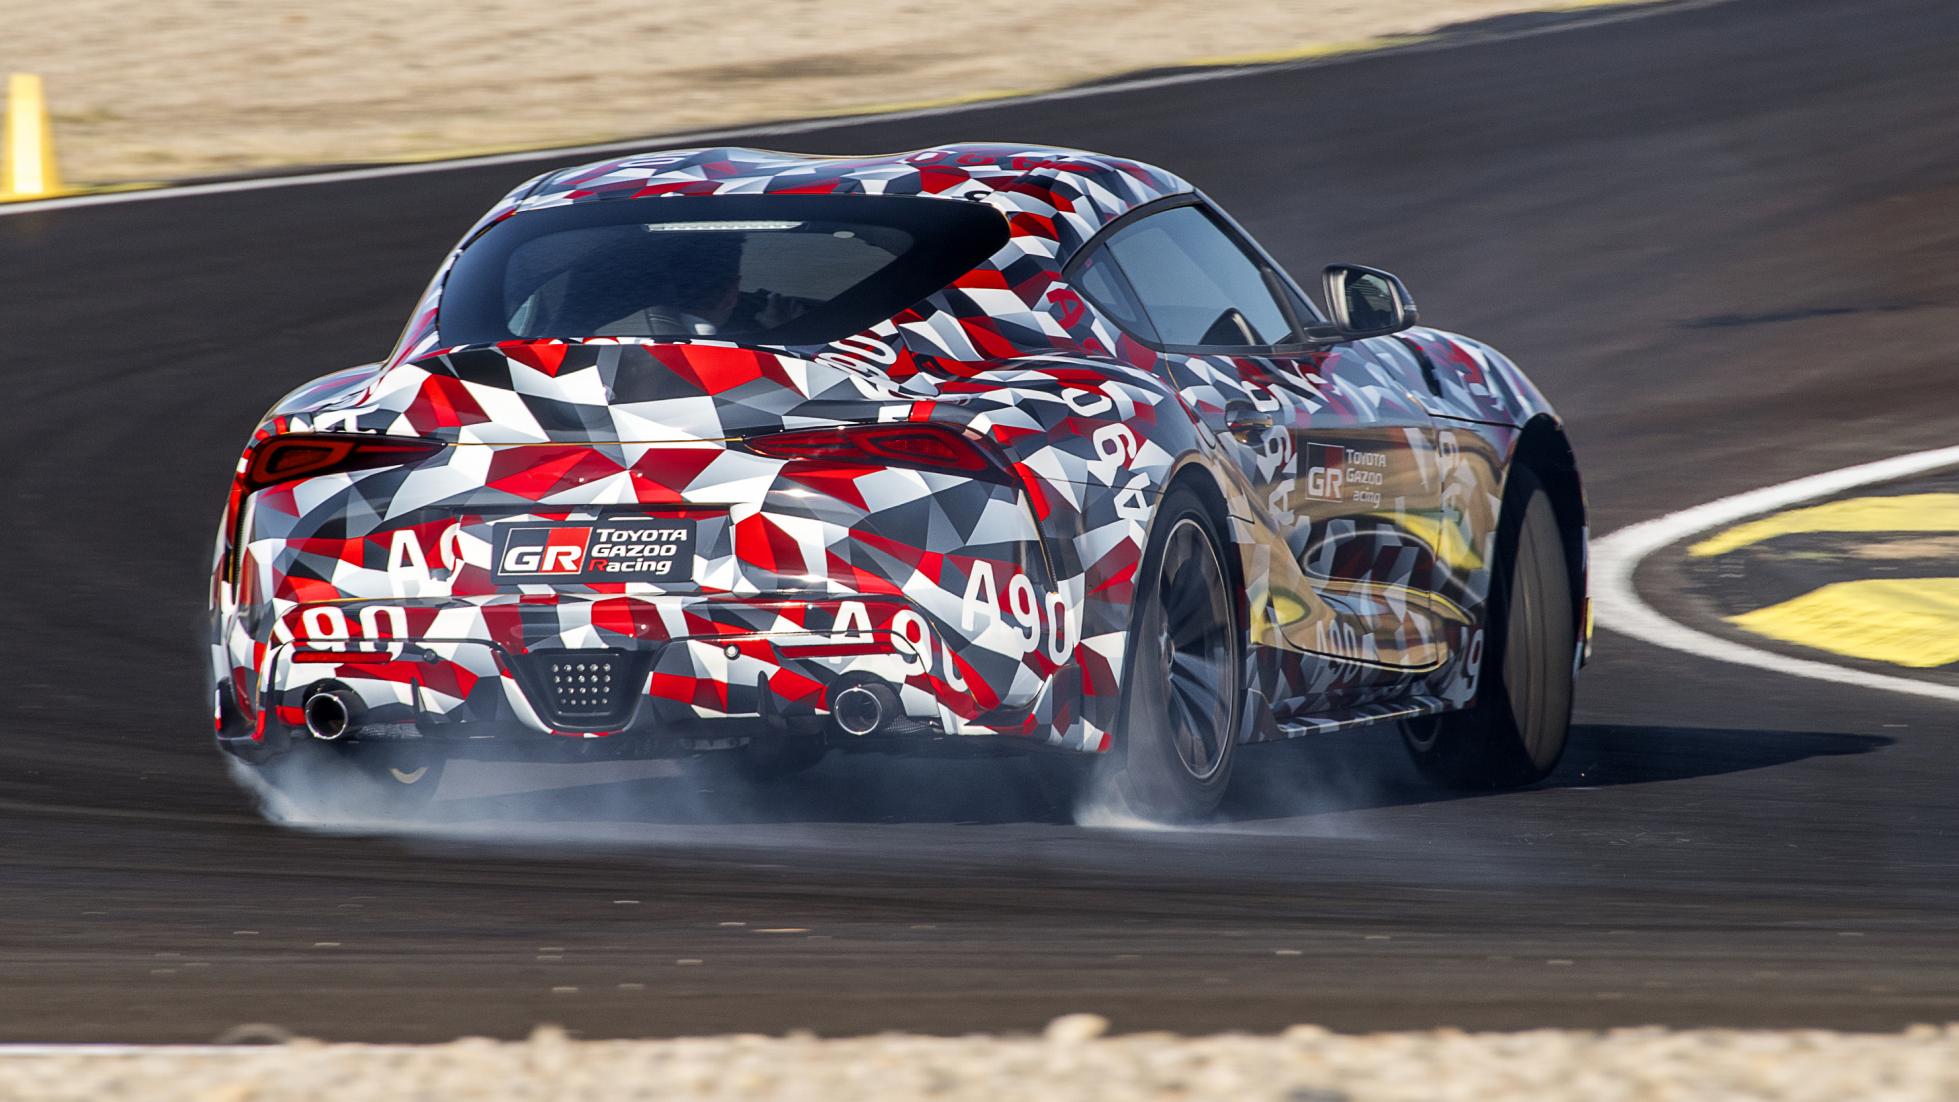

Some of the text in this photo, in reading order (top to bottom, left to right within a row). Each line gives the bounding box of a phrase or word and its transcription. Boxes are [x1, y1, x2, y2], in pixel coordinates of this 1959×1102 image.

[1061, 387, 1157, 522] A90
[1346, 449, 1386, 467] TOYOTA
[1308, 466, 1342, 498] GR
[1346, 468, 1383, 485] GAZOO
[1346, 486, 1381, 508] acing
[596, 528, 688, 542] TOYOTA
[503, 546, 582, 571] GR
[591, 544, 676, 558] GAZOO
[588, 558, 672, 575] Racing
[961, 559, 1075, 666] A90
